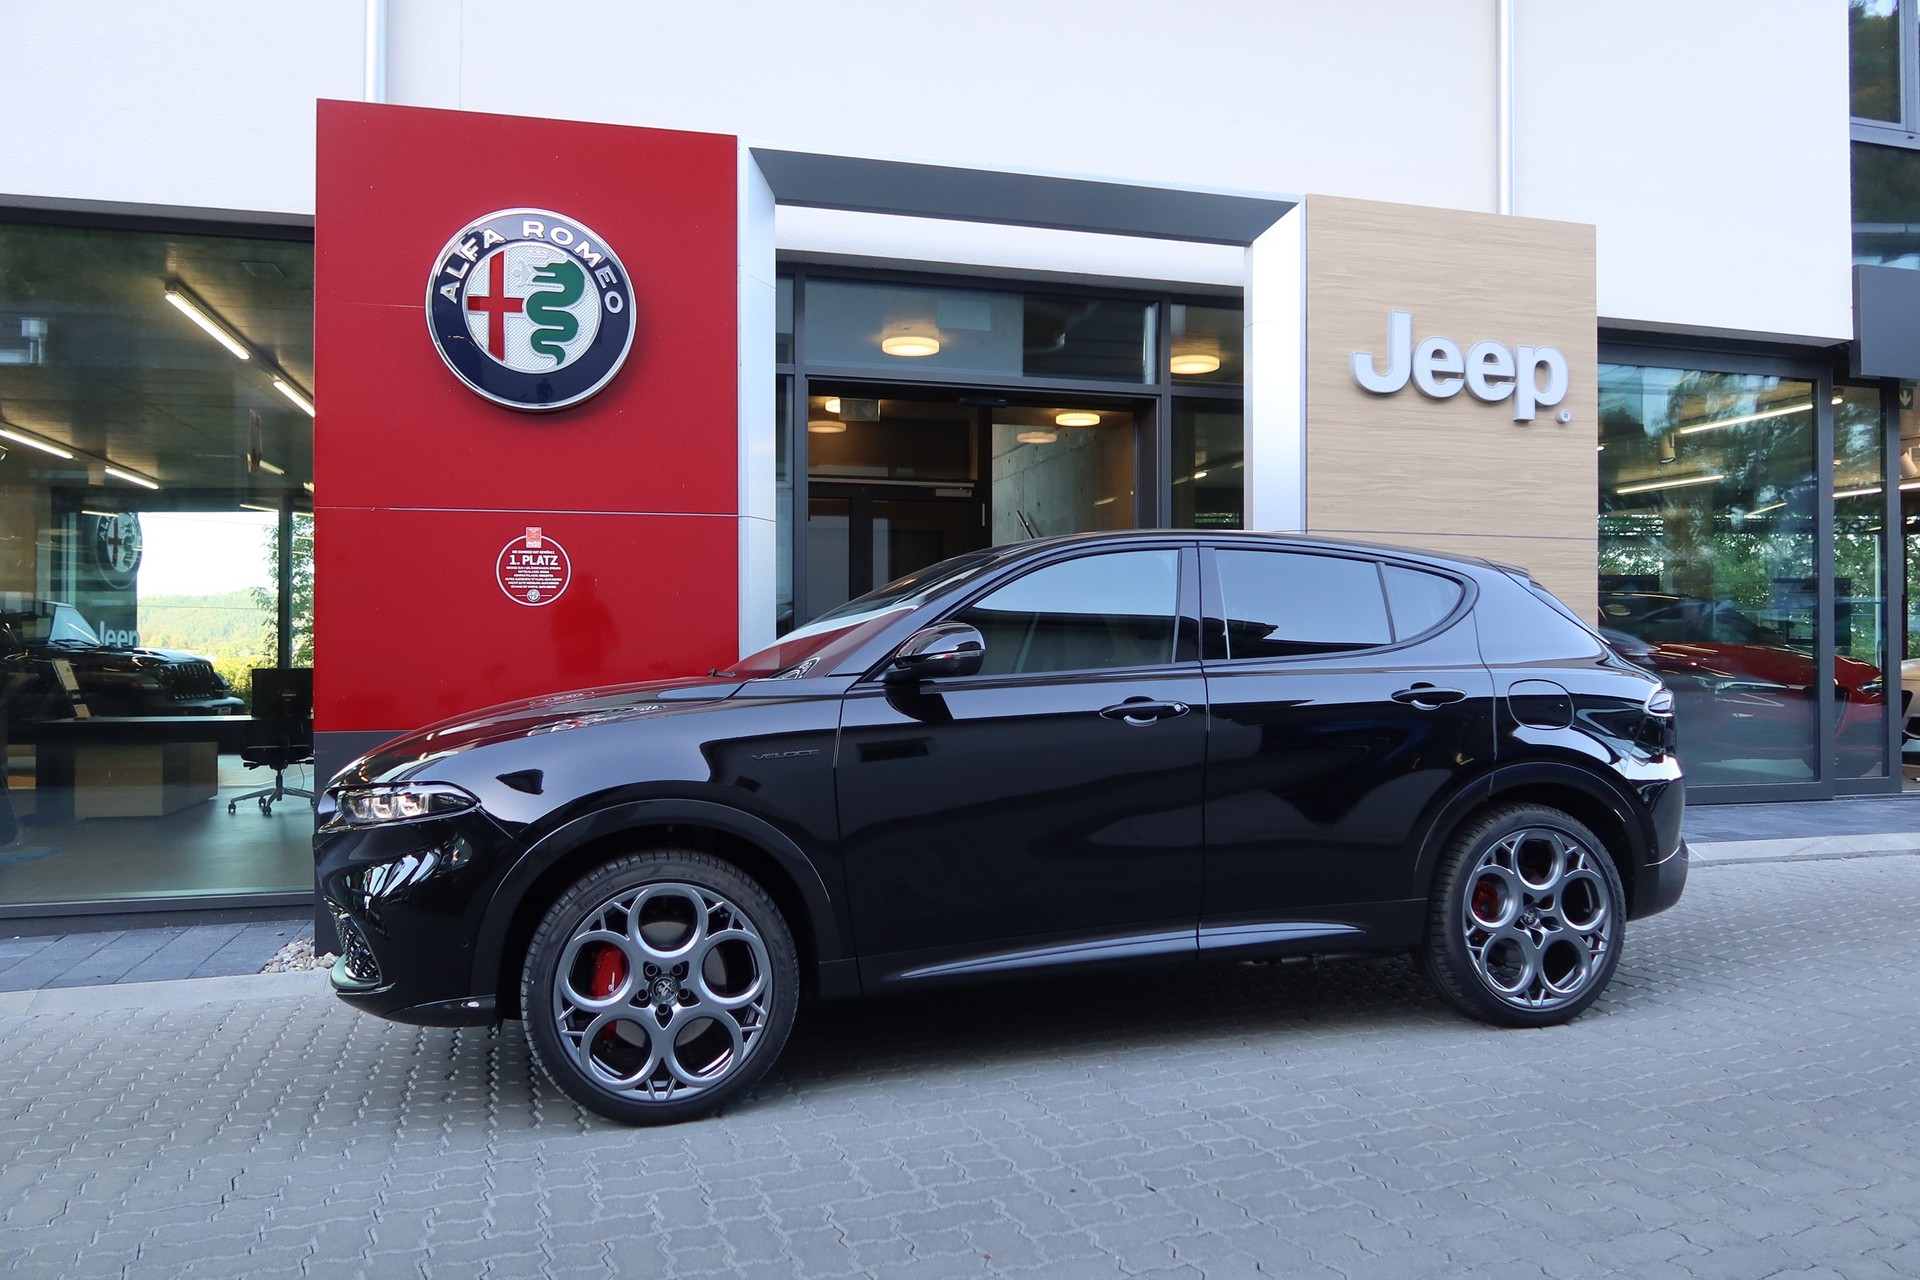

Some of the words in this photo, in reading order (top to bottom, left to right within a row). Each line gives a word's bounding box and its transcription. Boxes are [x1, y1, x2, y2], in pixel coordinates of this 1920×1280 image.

[440, 228, 507, 304] ALFA
[522, 220, 624, 315] ROMEO
[1351, 309, 1569, 422] Jeep
[509, 554, 520, 565] 1.
[522, 554, 559, 566] PLATZ
